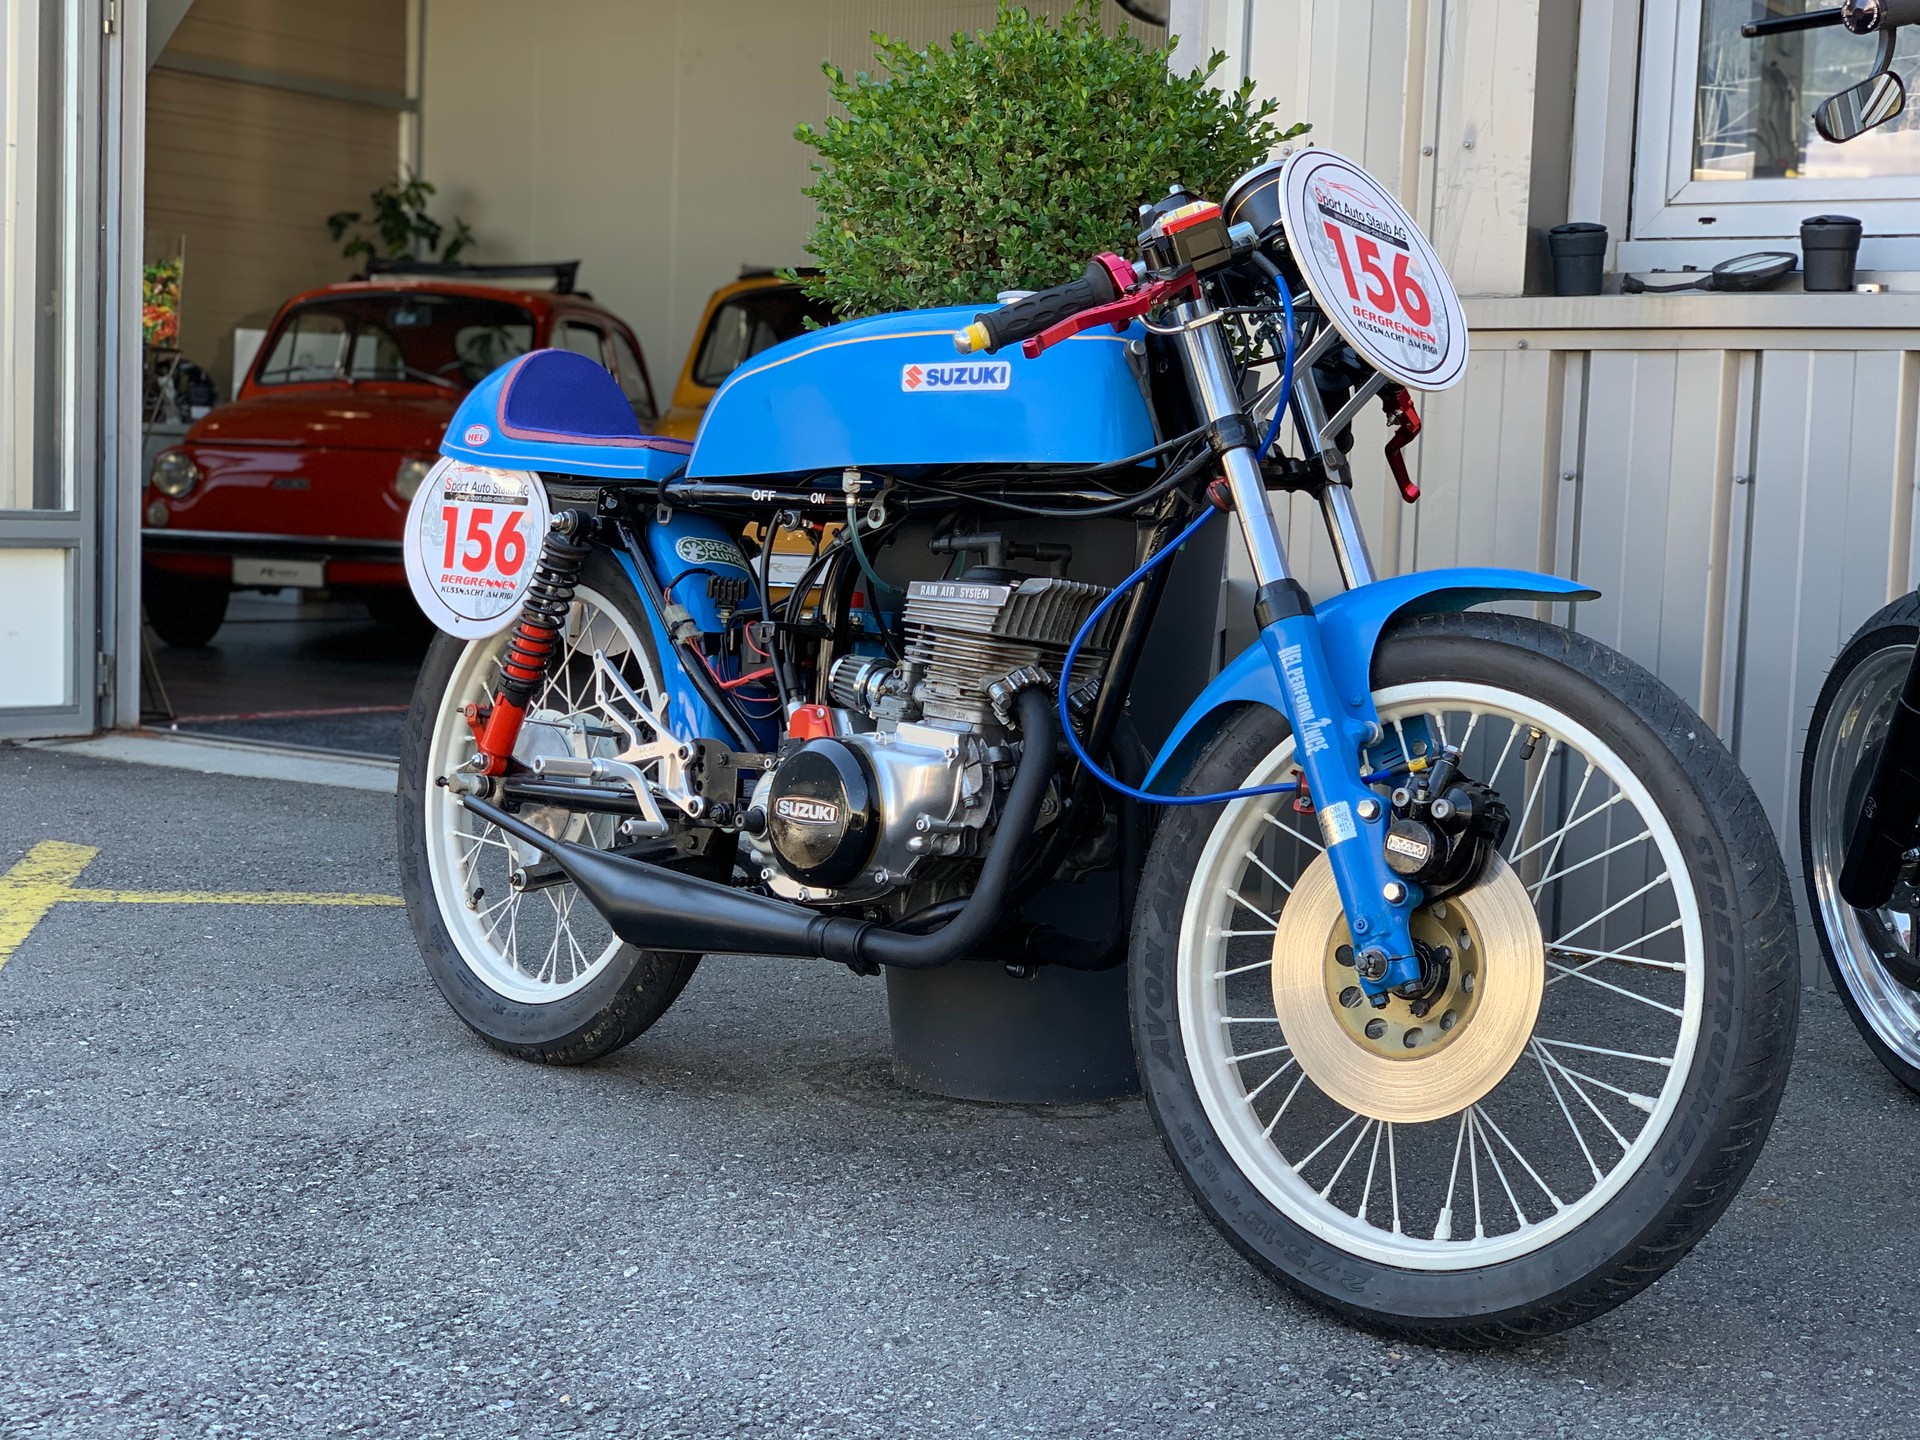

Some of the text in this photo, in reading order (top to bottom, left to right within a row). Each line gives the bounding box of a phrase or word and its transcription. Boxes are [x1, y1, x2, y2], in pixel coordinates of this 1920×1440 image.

[1314, 187, 1407, 240] Sport Auto Staub AG
[1323, 221, 1432, 327] 156
[1353, 305, 1436, 345] BERGRENNEN
[1408, 339, 1421, 350] AM
[1422, 343, 1438, 355] RIGI
[926, 366, 1007, 386] SUZUKI
[468, 434, 484, 442] HEL
[445, 478, 469, 493] Sport
[470, 481, 490, 493] Auto
[517, 484, 529, 496] AG
[752, 490, 826, 504] OFF ON
[442, 505, 526, 577] 156
[441, 573, 517, 590] BERGRENNEN
[498, 592, 514, 600] RIGI
[920, 585, 989, 599] RAM AIR SYSTEM
[1277, 644, 1331, 757] HEL PERFORMANCE
[779, 800, 835, 821] SUZUKI
